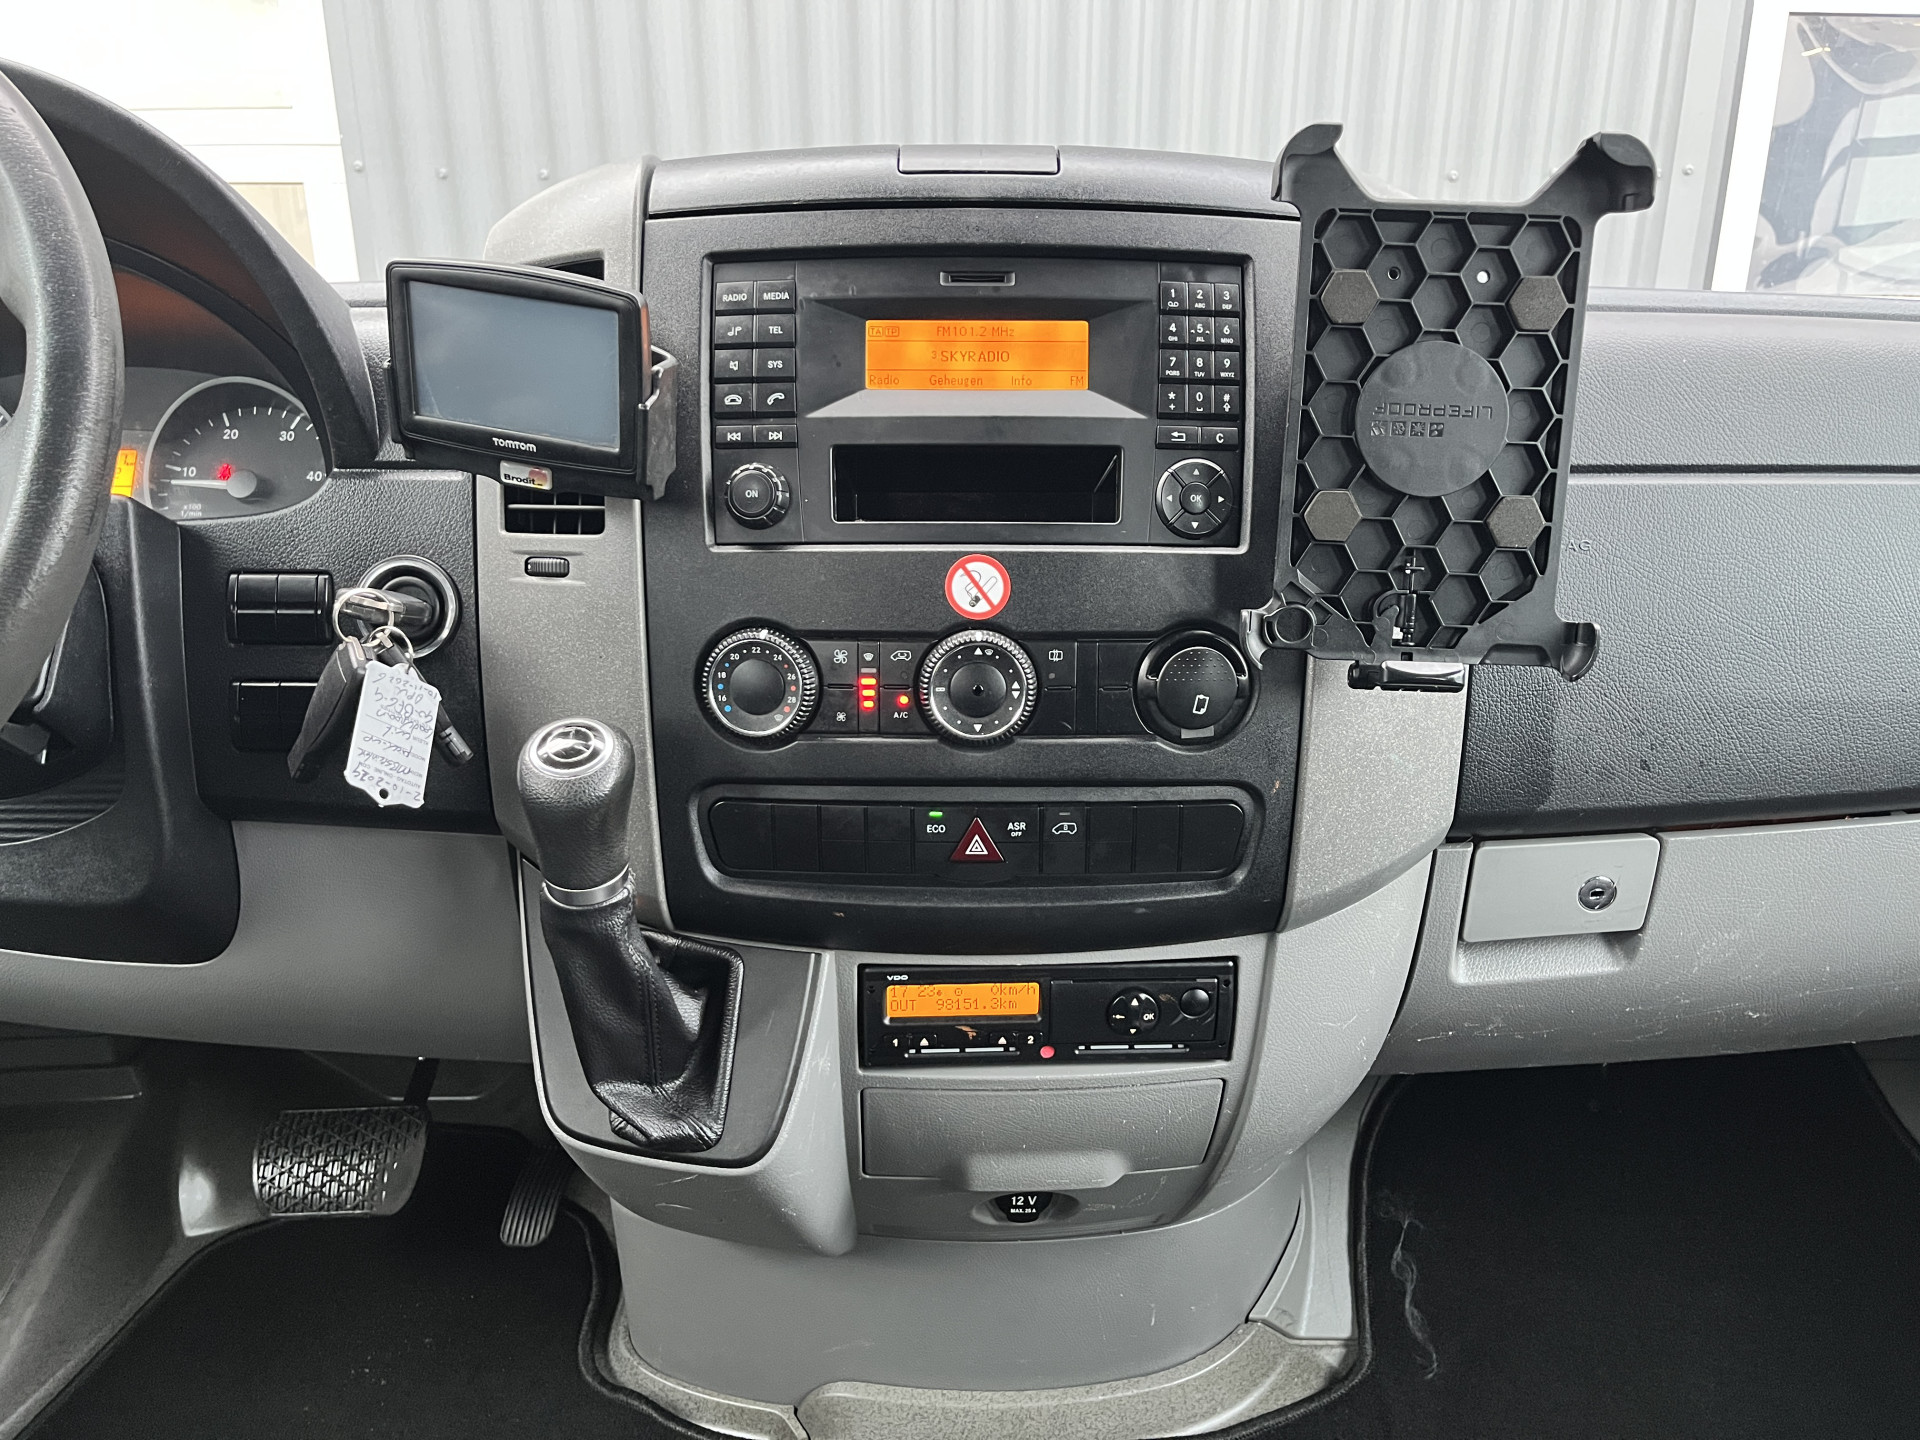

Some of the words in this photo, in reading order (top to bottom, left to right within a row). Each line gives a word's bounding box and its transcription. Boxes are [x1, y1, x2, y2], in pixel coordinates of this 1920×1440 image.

[722, 293, 748, 302] RADIO
[763, 291, 790, 301] MEDIA
[1170, 289, 1175, 298] 1
[1196, 290, 1203, 299] 2
[1223, 291, 1230, 300] 3
[768, 325, 784, 335] TEL
[992, 326, 1015, 337] MHz
[1169, 323, 1176, 332] 4
[1196, 324, 1203, 333] 5
[1223, 325, 1230, 334] 6
[940, 351, 1010, 362] SKYRADIO
[767, 360, 783, 369] SYS
[1169, 357, 1176, 366] 7
[1196, 358, 1203, 367] 8
[1223, 359, 1230, 368] 9
[869, 376, 900, 386] Radio
[929, 376, 983, 387] Geheugen
[1011, 376, 1032, 386] Info
[1070, 376, 1084, 386] FM
[1196, 392, 1203, 401] 0
[1372, 402, 1493, 419] LIFEPROOF
[222, 429, 239, 440] 20
[279, 430, 295, 441] 30
[1216, 433, 1224, 443] C
[182, 466, 197, 477] 10
[306, 471, 323, 481] 40
[504, 473, 536, 485] Brodit
[745, 489, 759, 498] ON
[1190, 494, 1202, 502] OK
[893, 711, 909, 719] A/C
[926, 825, 946, 833] ECO
[1007, 822, 1026, 830] ASR
[890, 1000, 917, 1011] OUT
[892, 1038, 899, 1047] 1
[1027, 1035, 1035, 1044] 2
[1011, 1196, 1024, 1205] 12
[1028, 1196, 1037, 1205] V
